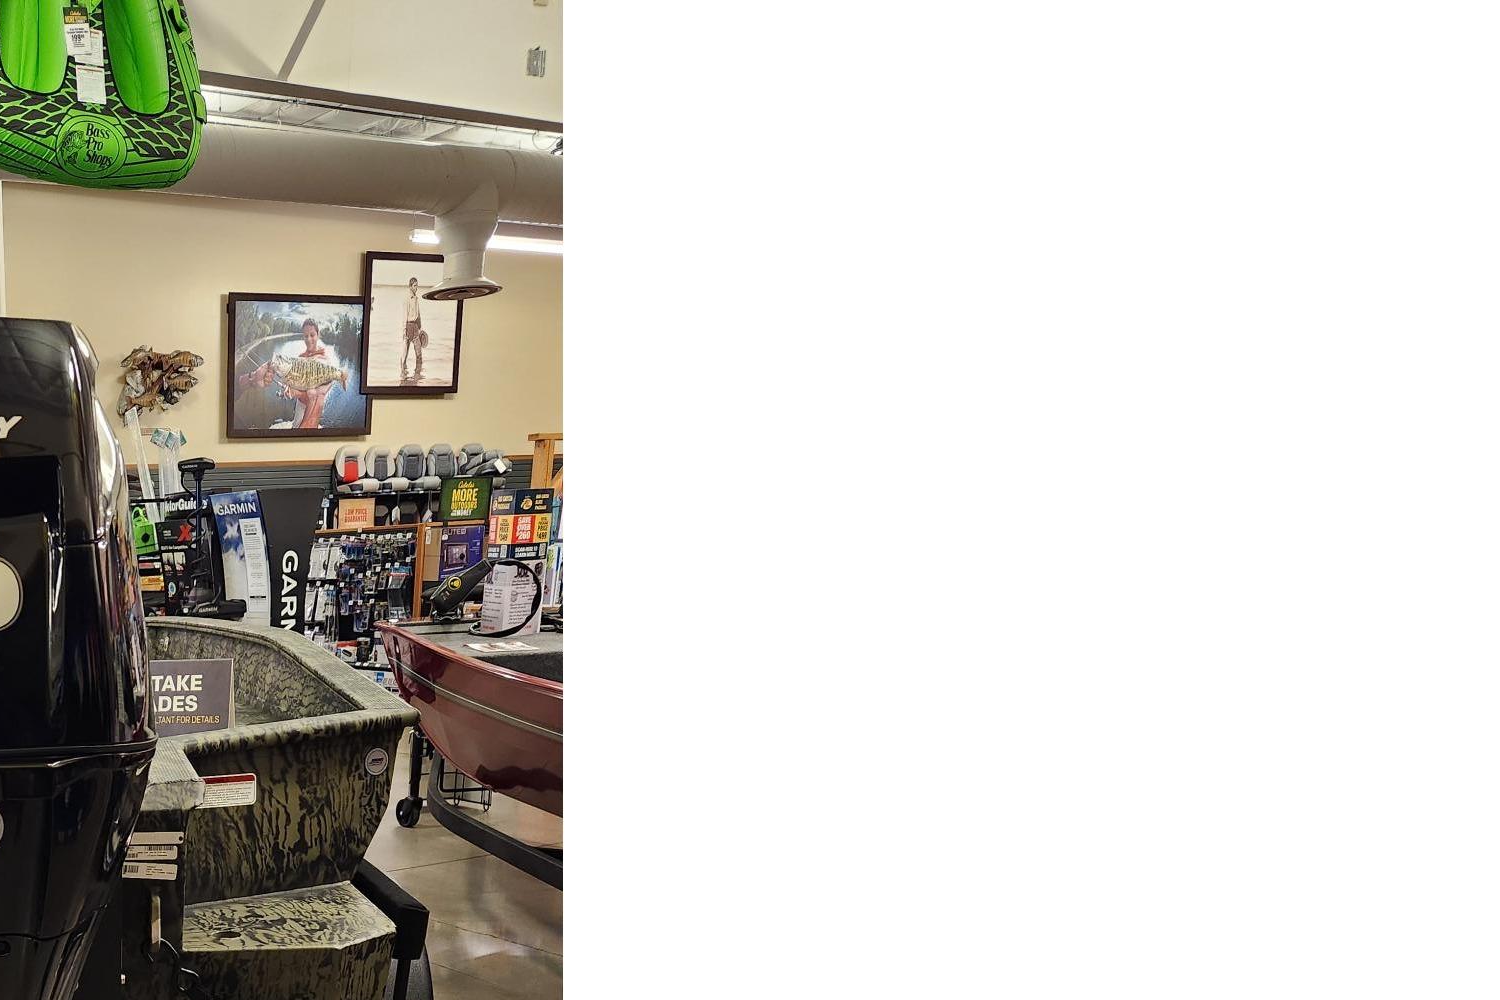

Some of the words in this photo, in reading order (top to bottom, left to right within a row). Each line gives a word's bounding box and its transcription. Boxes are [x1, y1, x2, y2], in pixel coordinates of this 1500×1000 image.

[86, 122, 110, 140] Bass
[86, 136, 104, 152] Pro
[83, 149, 113, 169] Shops
[452, 488, 479, 502] MORE
[217, 500, 257, 517] GARMIN
[151, 674, 203, 692] TAKE
[176, 715, 191, 724] FOR
[192, 715, 220, 724] DETAILS
